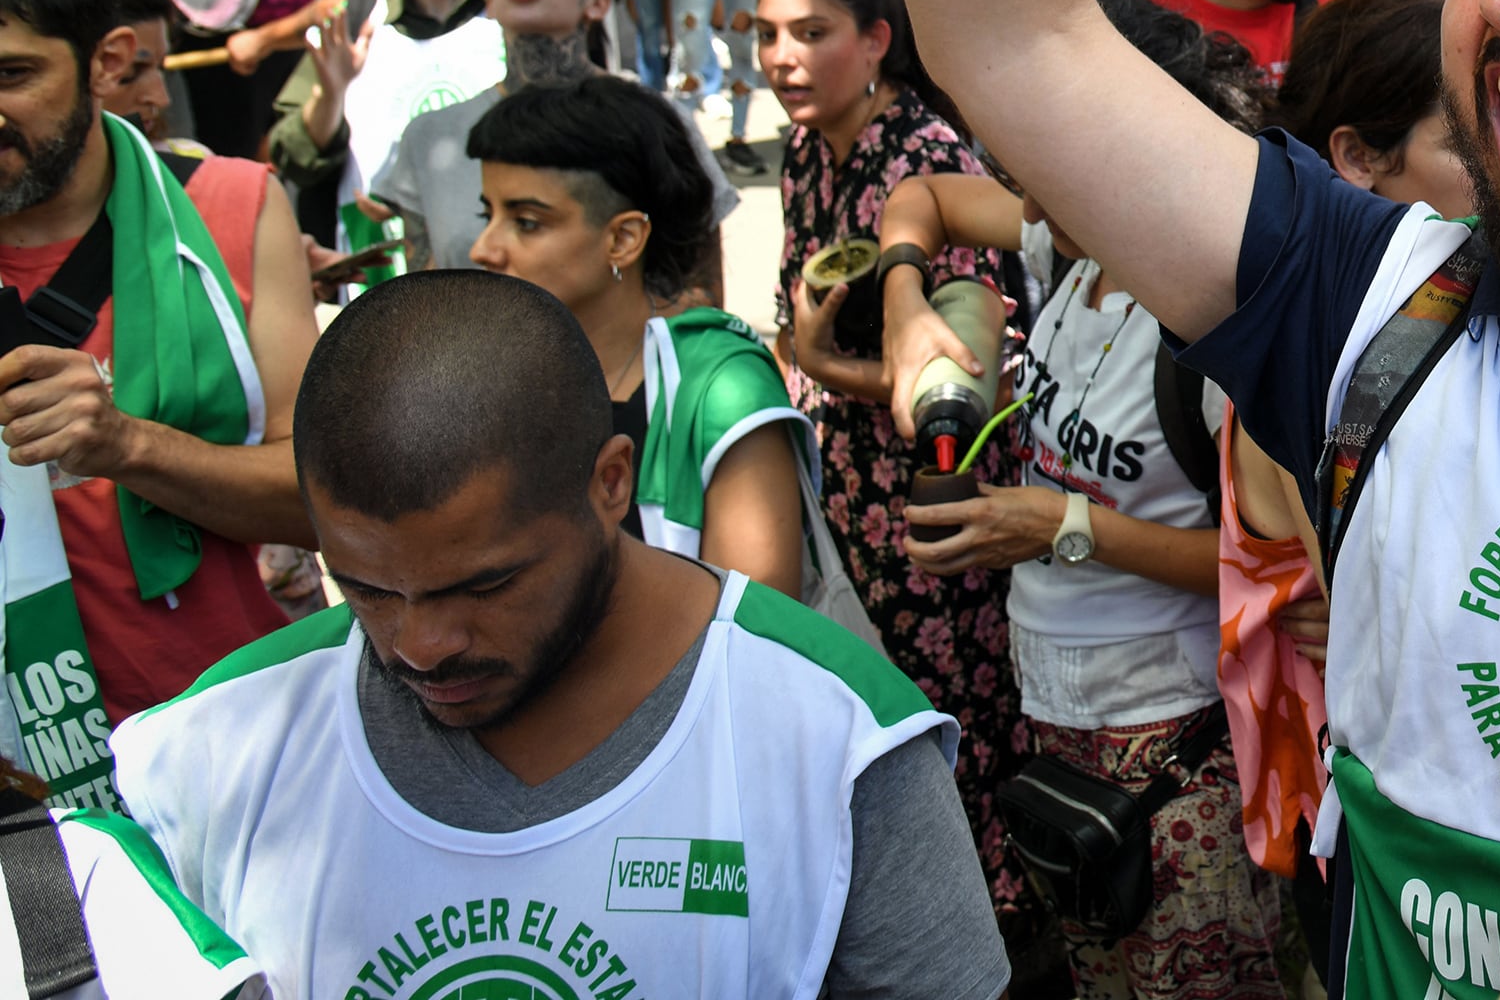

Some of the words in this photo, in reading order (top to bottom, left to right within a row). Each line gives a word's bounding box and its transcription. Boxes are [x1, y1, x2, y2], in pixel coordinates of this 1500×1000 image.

[1056, 407, 1146, 483] GRIS
[6, 648, 98, 727] LOS
[617, 860, 682, 889] VERDE
[690, 861, 748, 894] BLANC
[518, 899, 559, 954] EL
[558, 921, 645, 1000] ESTA
